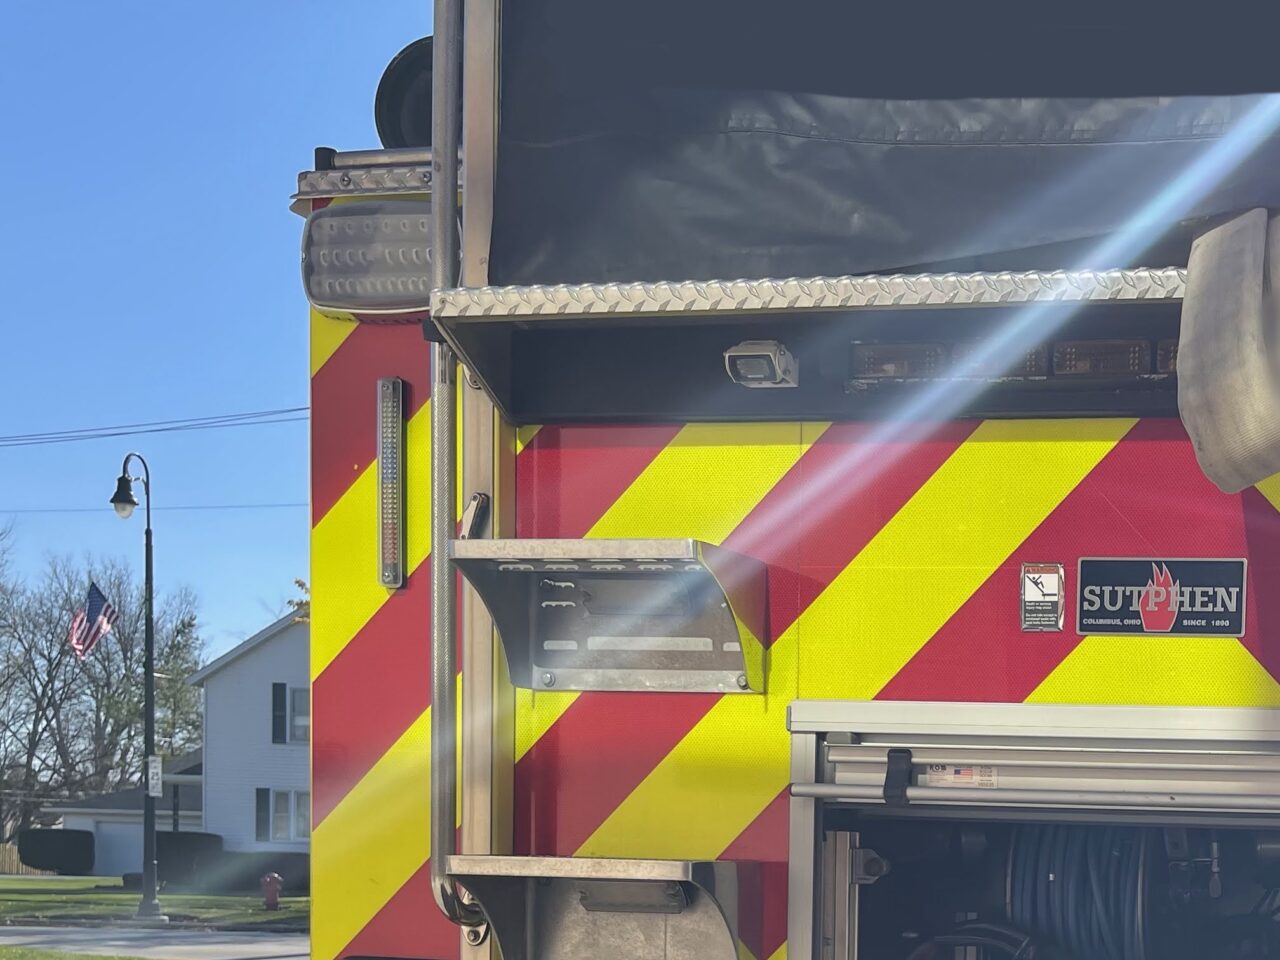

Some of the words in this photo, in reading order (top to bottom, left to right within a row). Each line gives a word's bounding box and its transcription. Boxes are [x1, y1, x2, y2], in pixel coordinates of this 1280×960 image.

[1083, 585, 1240, 612] SUTPHEN
[1123, 618, 1142, 626] OHIO
[1182, 619, 1207, 627] SINCE
